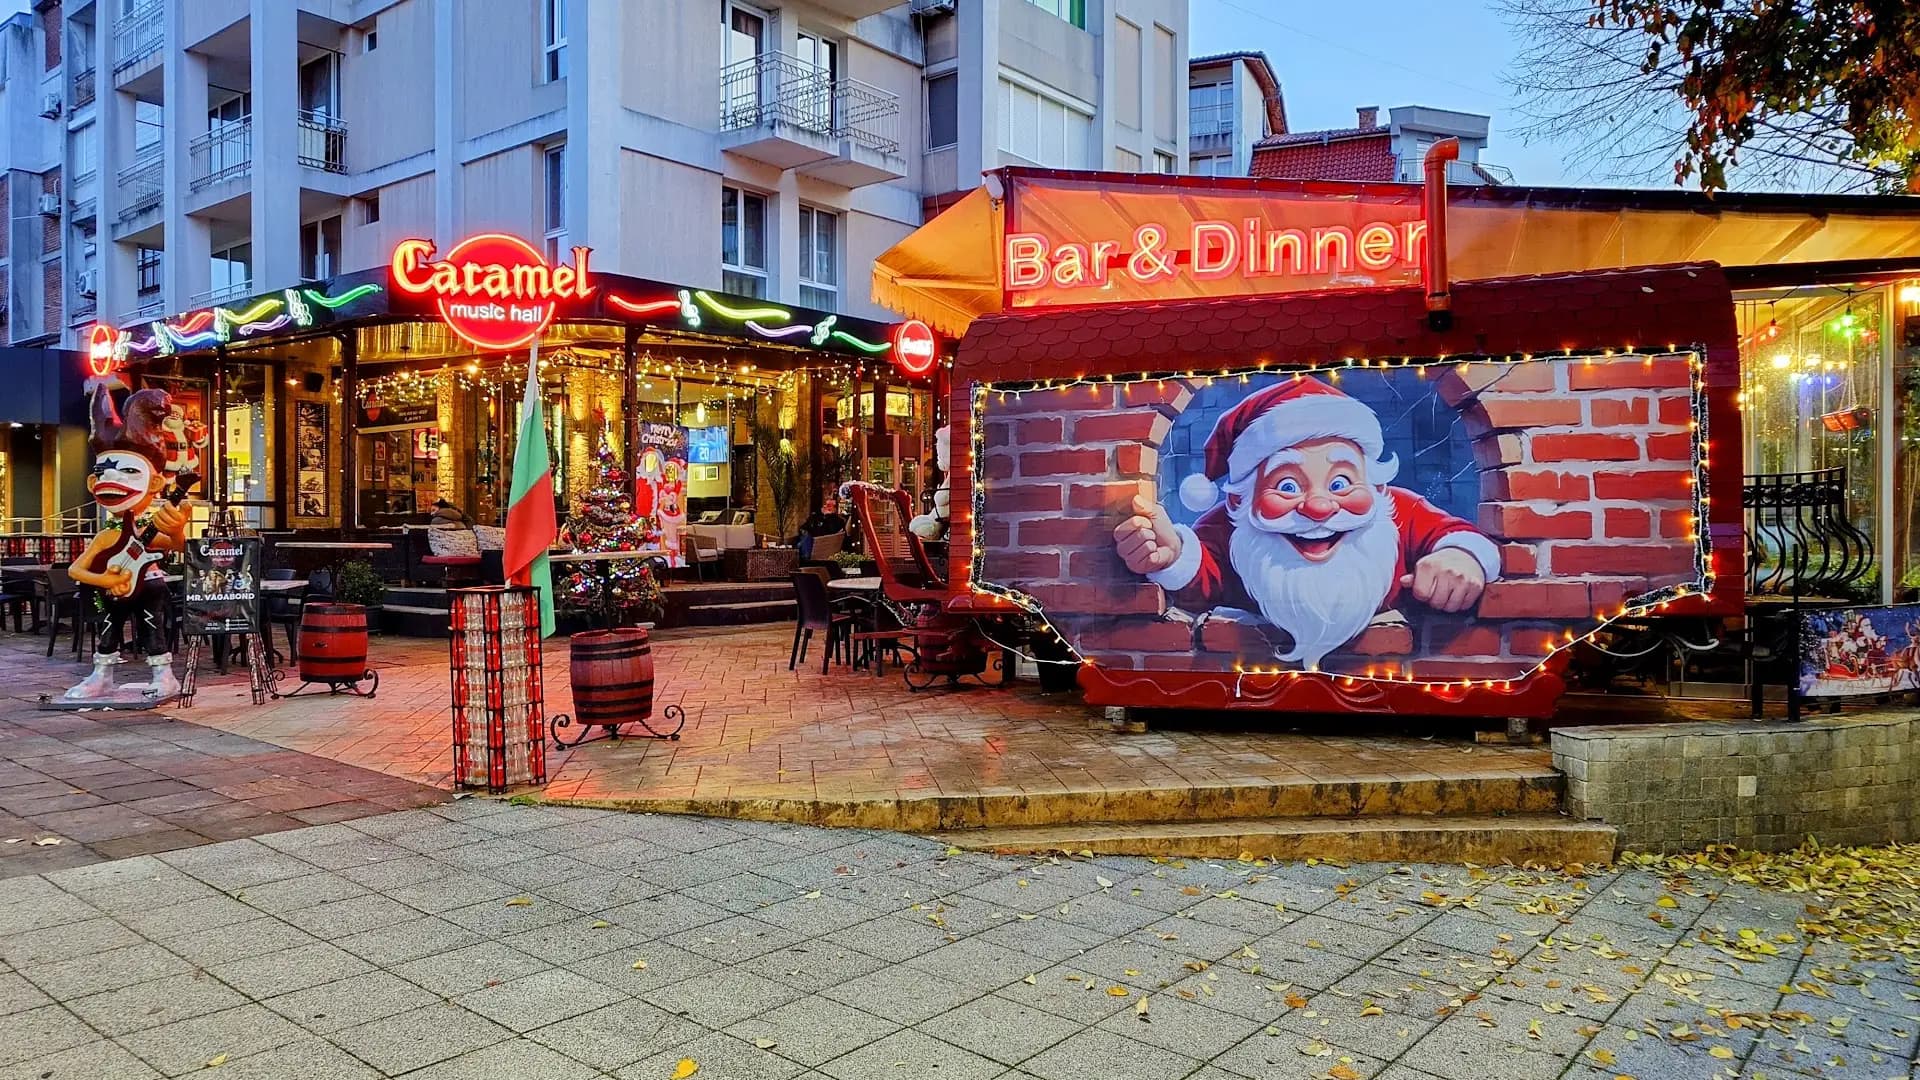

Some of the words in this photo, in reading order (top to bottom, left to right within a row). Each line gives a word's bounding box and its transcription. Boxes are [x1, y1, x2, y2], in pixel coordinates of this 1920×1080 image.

[392, 238, 596, 299] Caramel
[1006, 233, 1120, 290] Bar
[1127, 223, 1176, 283] &
[1191, 216, 1427, 282] Dinner
[450, 303, 505, 320] music
[510, 304, 542, 323] hall
[200, 544, 243, 556] Caramel
